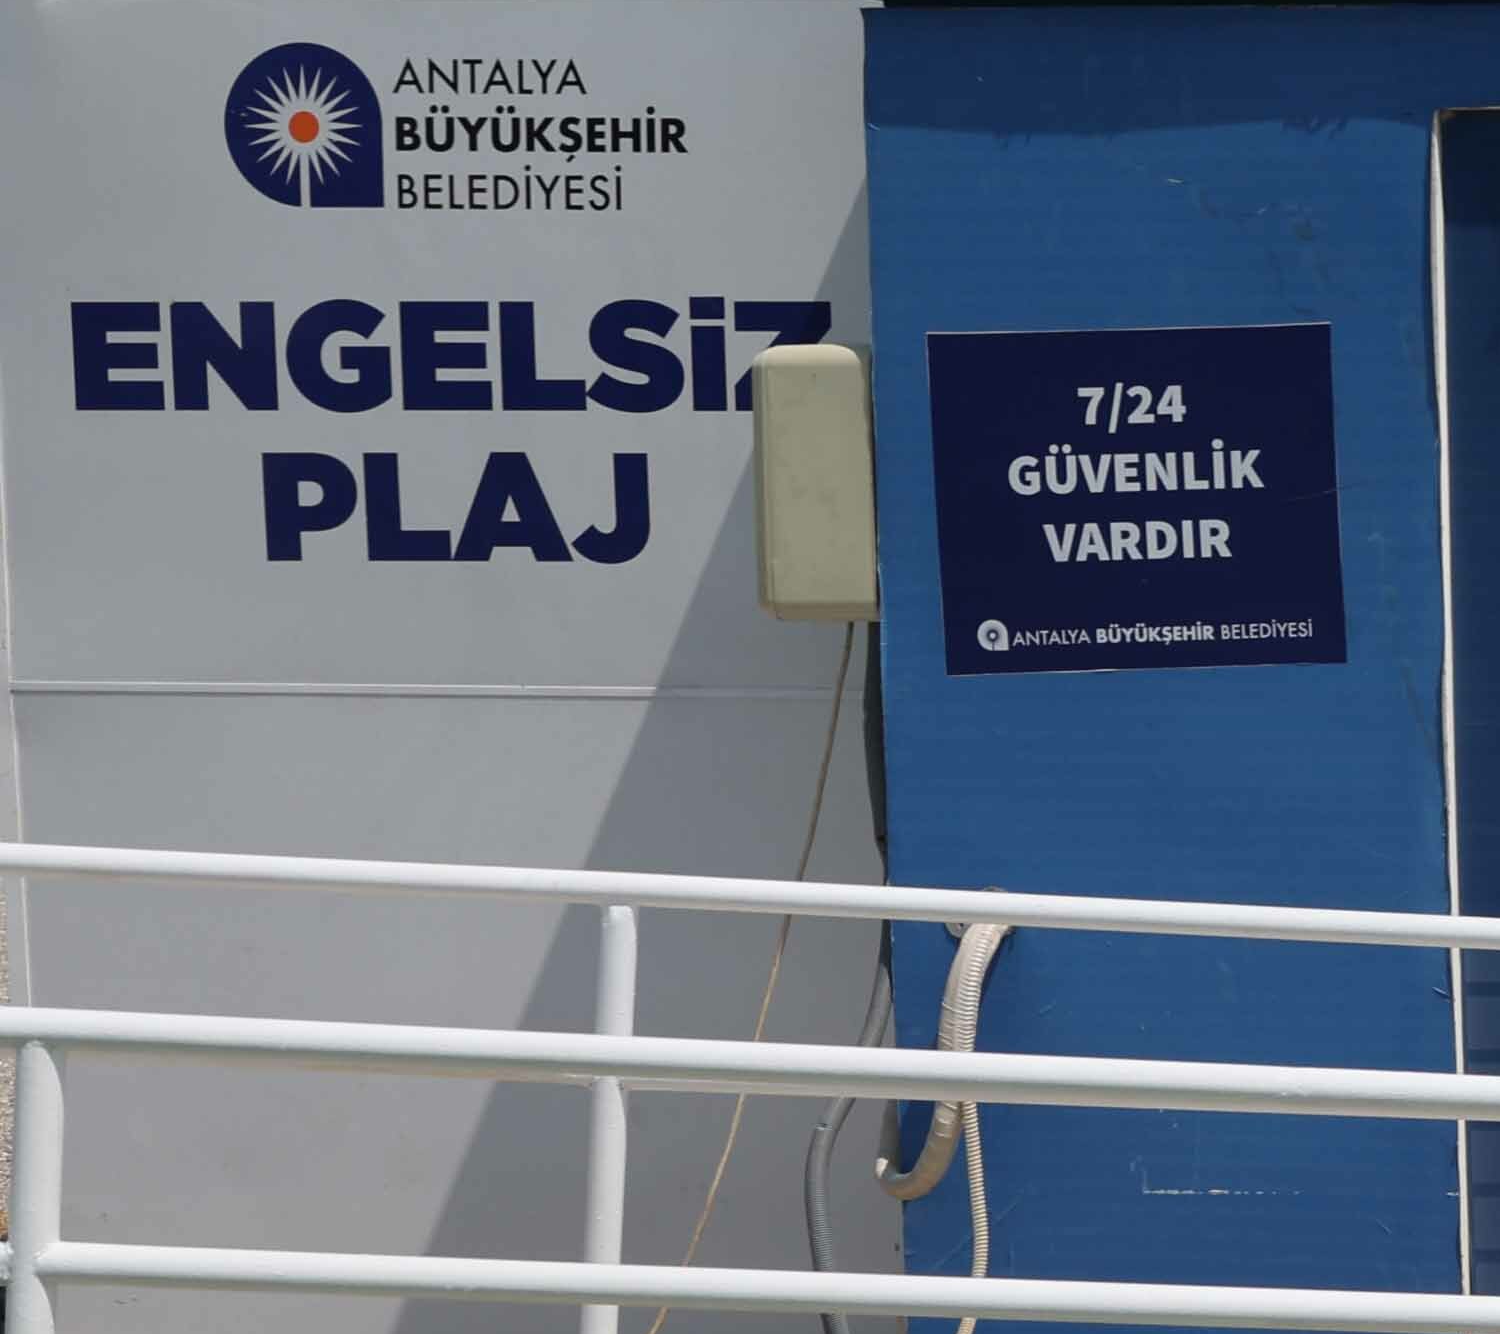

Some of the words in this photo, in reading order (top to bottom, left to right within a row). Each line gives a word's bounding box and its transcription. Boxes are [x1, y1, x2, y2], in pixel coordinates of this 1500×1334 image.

[392, 58, 588, 96] ANTALYA
[395, 104, 689, 163] BÜYÜKŞEHİR
[397, 164, 624, 212] BELEDİYESİ
[1076, 381, 1188, 435] 7/24
[1007, 438, 1265, 497] GÜVENLİK
[261, 451, 652, 565] PLAJ
[1042, 518, 1233, 563] VARDIR
[1012, 627, 1091, 648] ANTALYA
[1095, 620, 1216, 646] BÜYÜKŞEHİR
[1220, 618, 1314, 642] BELEDİYESİ
